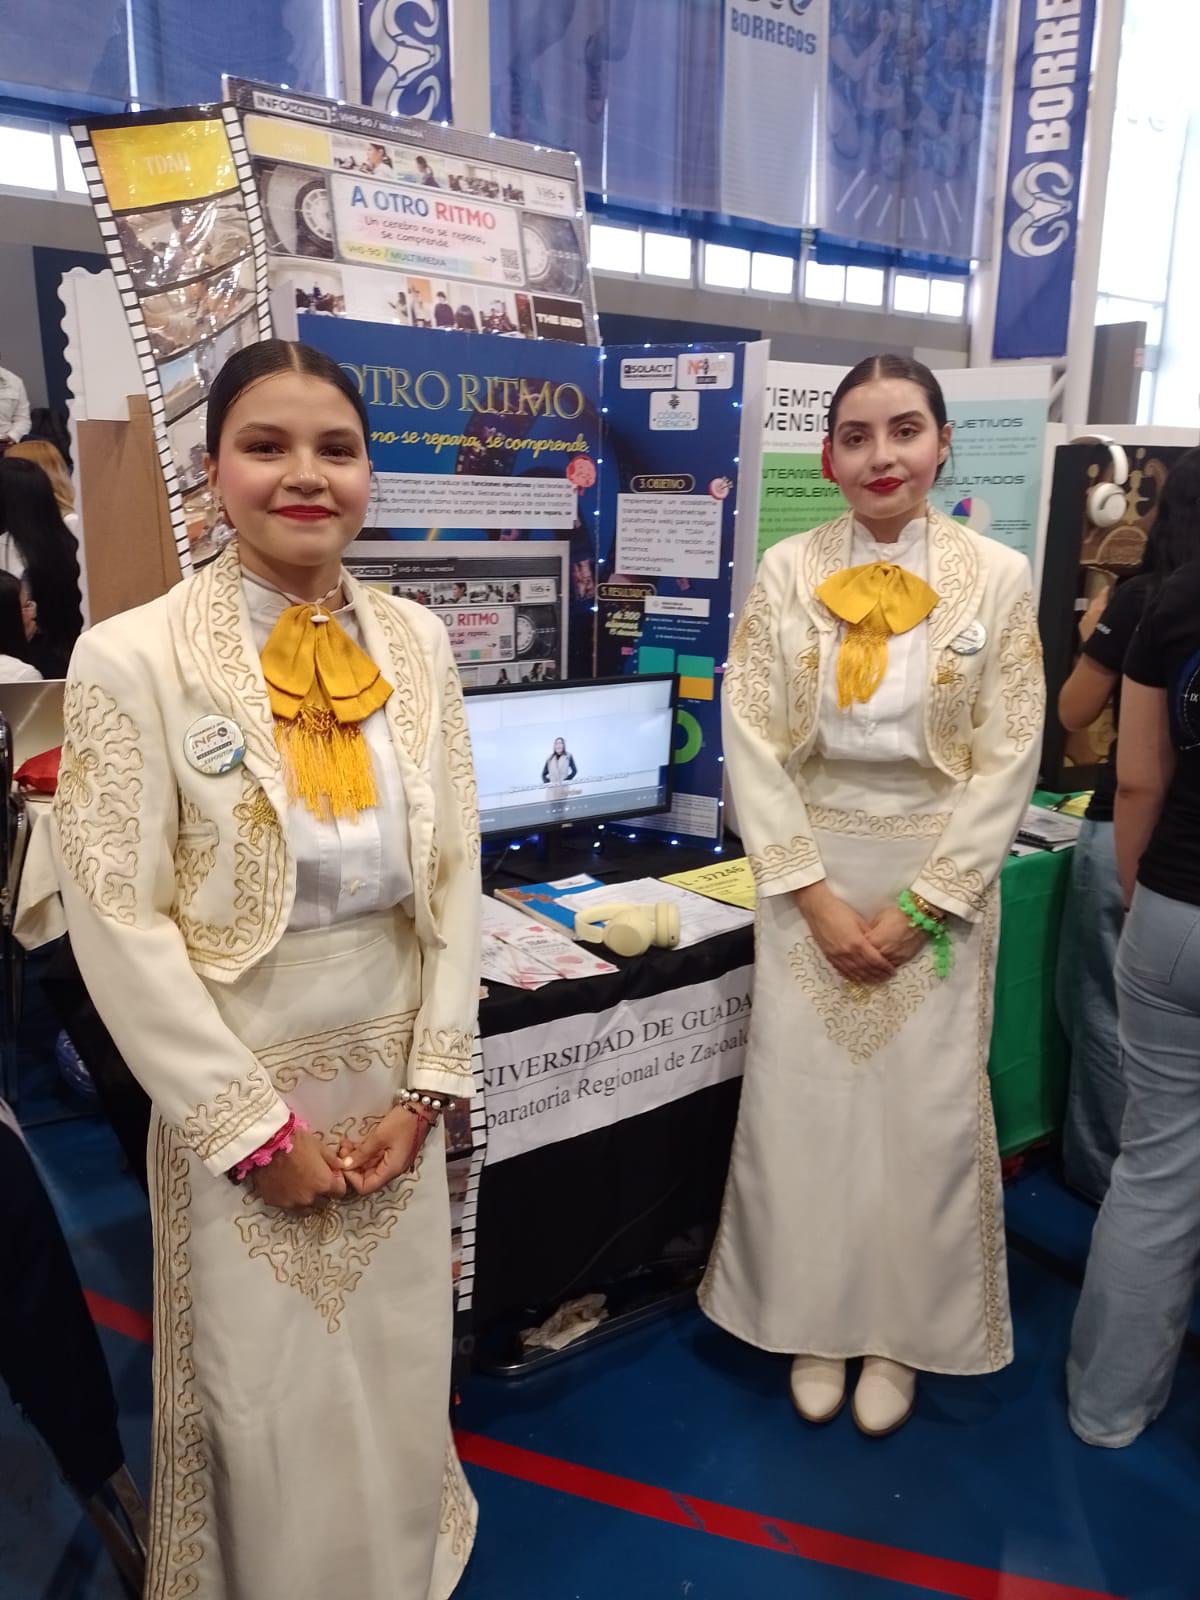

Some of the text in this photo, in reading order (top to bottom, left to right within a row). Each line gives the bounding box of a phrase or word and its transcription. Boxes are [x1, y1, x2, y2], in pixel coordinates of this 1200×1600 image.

[731, 7, 816, 55] BORREGOS
[350, 185, 496, 231] A OTRO RITMO
[364, 215, 378, 227] Un
[422, 225, 435, 235] no
[438, 227, 449, 237] se
[536, 312, 583, 328] THE END
[632, 364, 673, 374] SOLACYT
[457, 373, 585, 420] RITMO
[370, 429, 399, 444] no
[401, 429, 421, 445] se
[485, 433, 504, 448] se
[504, 433, 590, 459] comprende
[766, 487, 840, 498] PROBLEMA
[458, 612, 499, 626] RITMO
[484, 992, 752, 1088] NIVERSIDAD DE GUADA
[486, 1085, 571, 1135] paratoria
[577, 1056, 659, 1099] Regional
[664, 1051, 685, 1072] de
